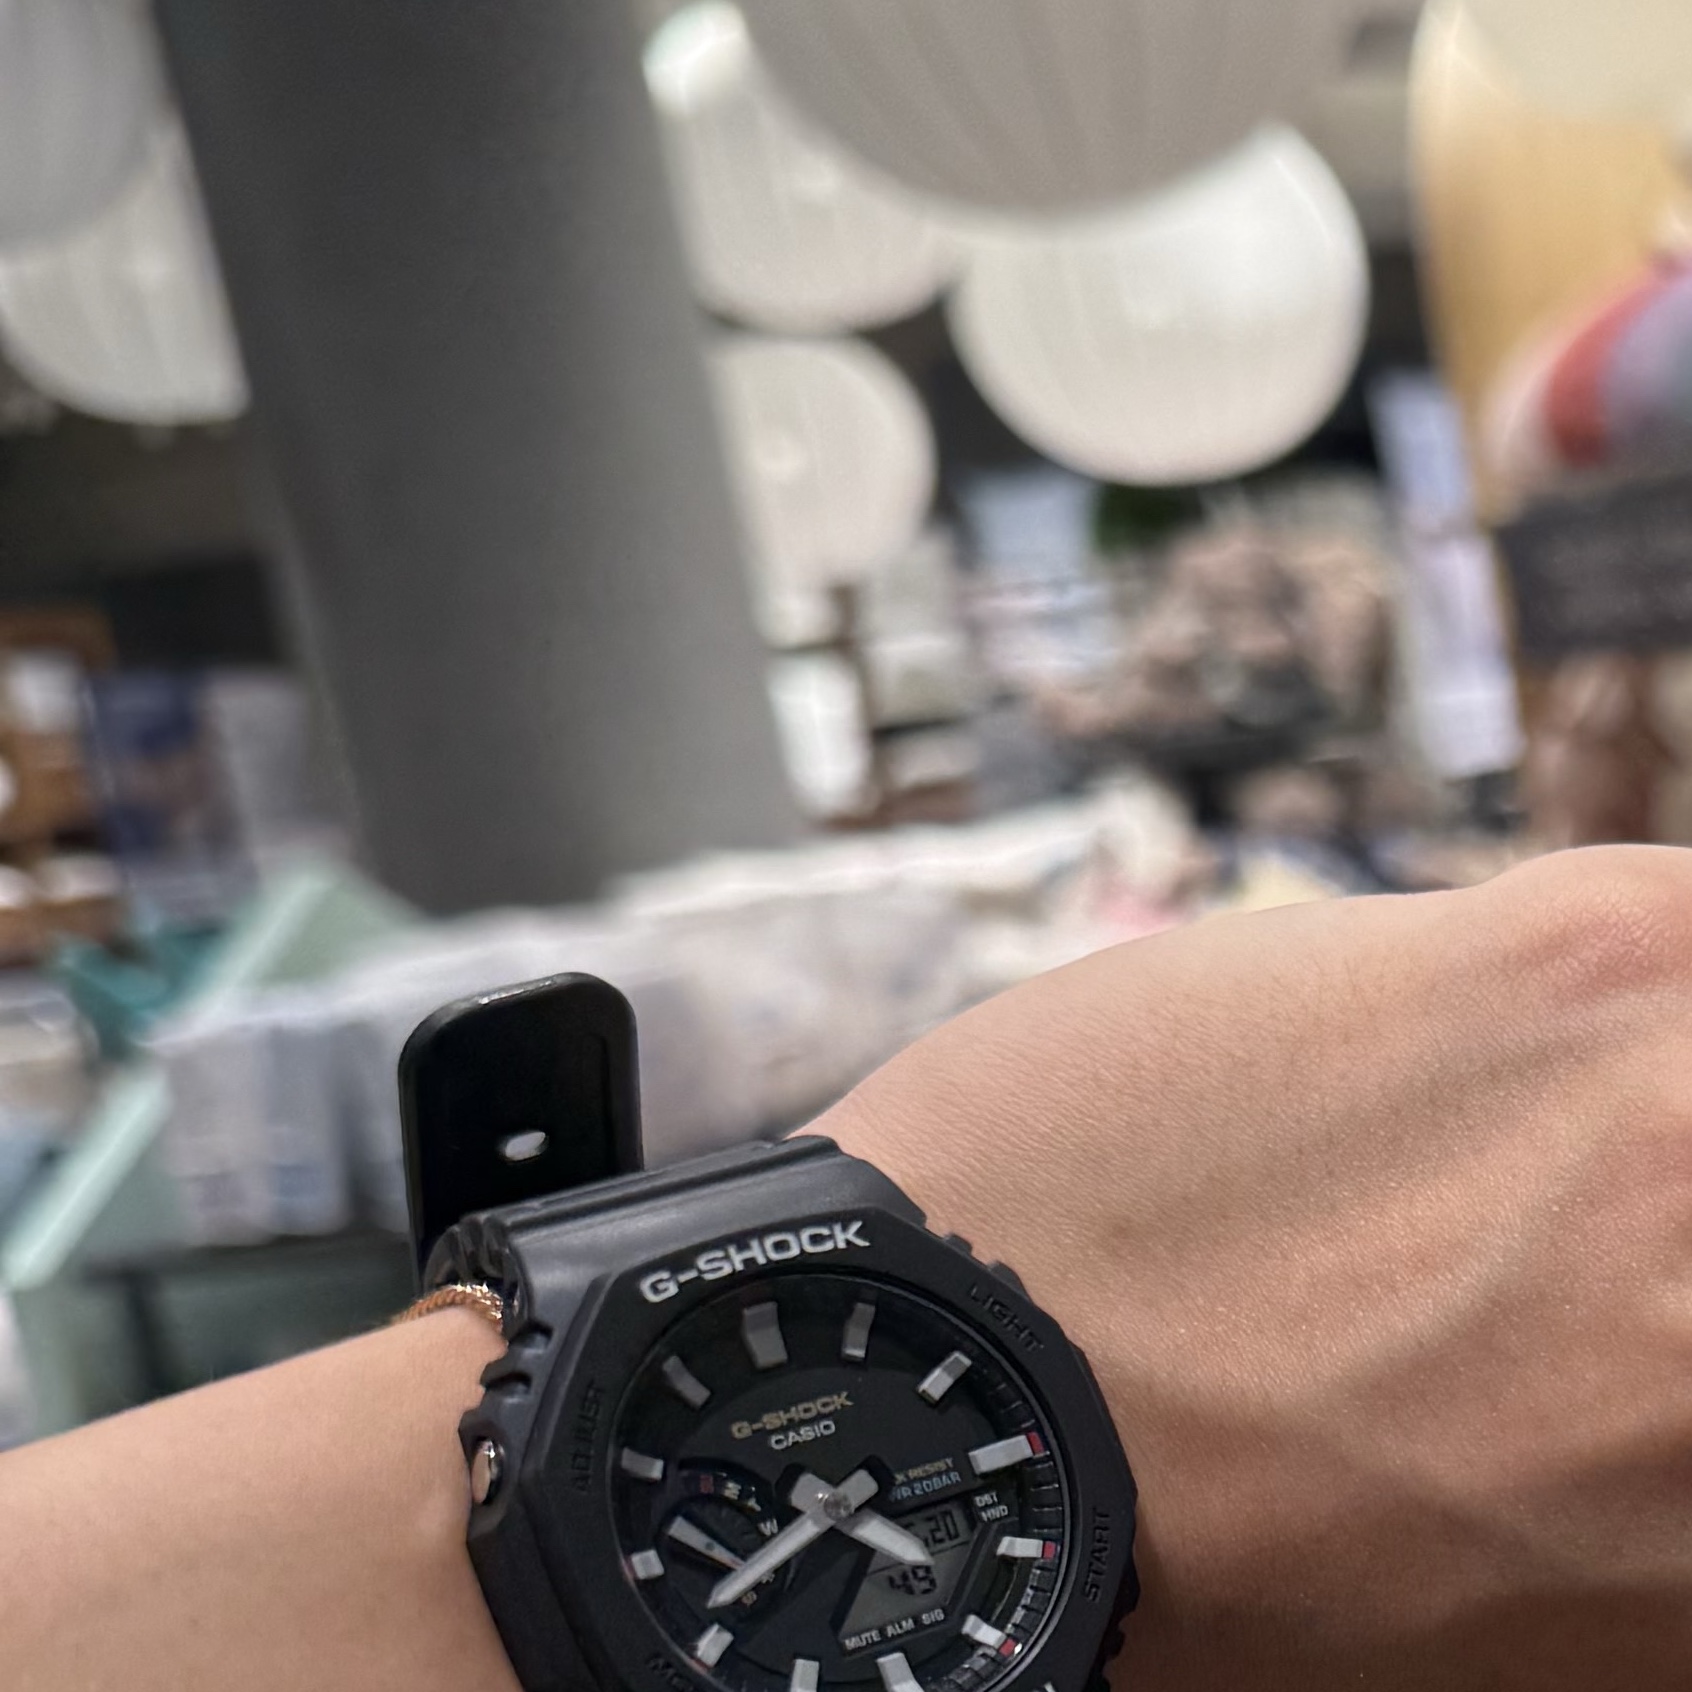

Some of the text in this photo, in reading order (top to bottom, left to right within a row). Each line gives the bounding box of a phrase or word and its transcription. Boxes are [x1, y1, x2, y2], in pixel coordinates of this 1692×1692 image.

[639, 1220, 870, 1305] G-SHOCK
[968, 1282, 1044, 1352] LIGHT
[731, 1391, 854, 1440] G-SHOCK
[769, 1419, 837, 1451] CASIO
[974, 1491, 999, 1507] DST
[1083, 1505, 1110, 1602] START
[887, 1564, 937, 1596] 49
[844, 1608, 946, 1652] MUTE ALM SIG
